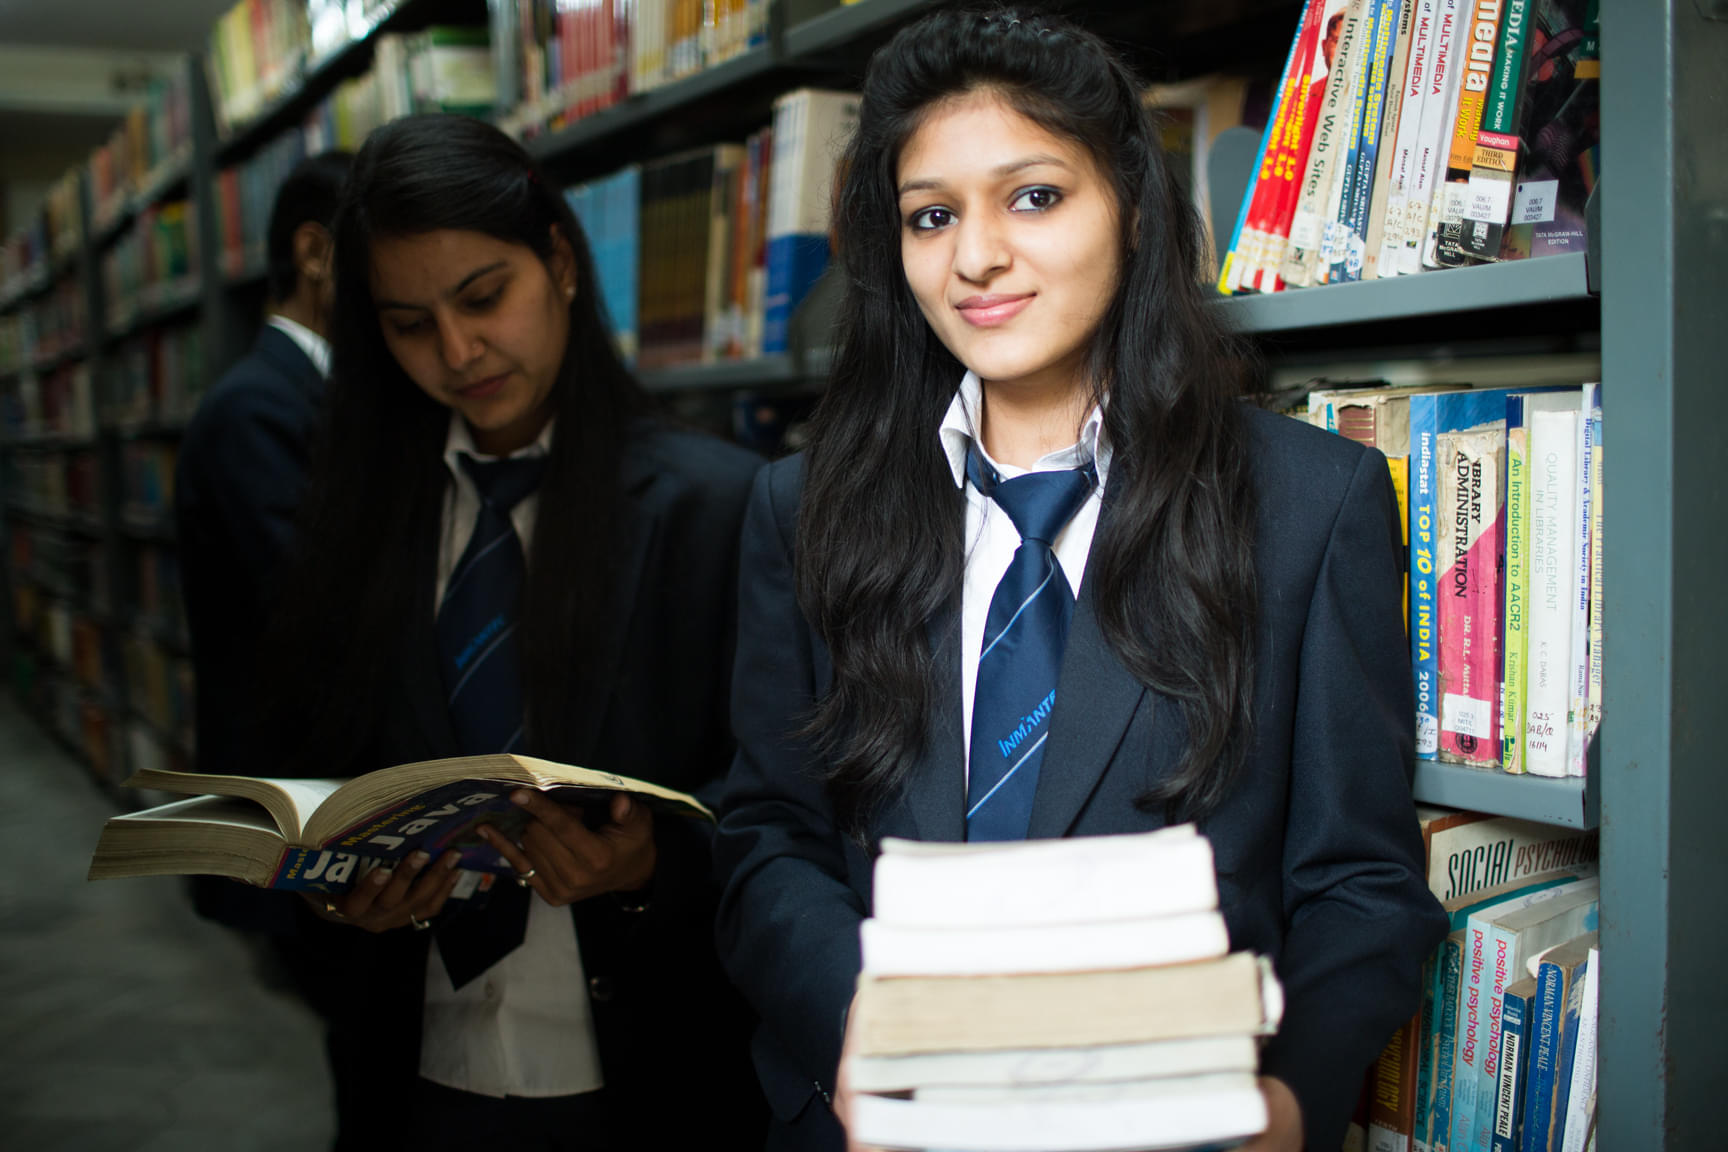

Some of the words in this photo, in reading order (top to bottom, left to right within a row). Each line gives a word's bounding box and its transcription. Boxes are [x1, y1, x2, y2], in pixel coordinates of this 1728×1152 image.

[1423, 2, 1432, 13] of
[1327, 18, 1358, 108] Interactive
[1357, 17, 1375, 98] Multimedia
[1375, 9, 1393, 91] Multimedia
[1409, 17, 1430, 97] MULTIMEDIA
[1431, 13, 1453, 96] MULTIMEDIA
[1268, 78, 1296, 150] Silverlight
[1290, 74, 1311, 150] Silverlight
[1499, 91, 1507, 100] IT
[1316, 114, 1336, 152] Web
[1349, 98, 1362, 150] System
[1367, 93, 1381, 145] System
[1455, 109, 1472, 138] Work
[1493, 101, 1505, 130] WORK
[1260, 157, 1274, 180] 1.0
[1284, 156, 1296, 181] 1.0
[1480, 149, 1503, 160] THIRD
[1307, 159, 1325, 197] Sites
[1547, 237, 1570, 246] EDITION
[1583, 418, 1593, 449] Digital
[1511, 459, 1523, 477] An
[1545, 452, 1558, 512] QUALITY
[1583, 451, 1592, 484] Library
[1535, 489, 1545, 502] IN
[1583, 487, 1590, 495] &
[1418, 504, 1430, 543] TOP
[1454, 450, 1470, 599] ADMINISTRATION
[1510, 481, 1523, 559] Introduction
[1581, 499, 1590, 540] Academic
[1534, 509, 1545, 574] LIBRARIES
[1579, 543, 1590, 572] Society
[1417, 548, 1432, 575] 10
[1510, 565, 1520, 577] to
[1545, 516, 1558, 611] MANAGEMENT
[1579, 575, 1588, 585] in
[1418, 580, 1431, 600] of
[1509, 583, 1521, 632] AACR2
[1579, 587, 1588, 610] India
[1418, 605, 1430, 662] INDIA
[1463, 615, 1472, 636] DR.
[1508, 651, 1520, 687] Krishan
[1418, 672, 1429, 713] 2006
[1506, 691, 1518, 723] Kumar
[367, 791, 501, 851] Java
[1445, 837, 1515, 901] SOCIAL
[1470, 928, 1485, 986] positive
[1493, 938, 1509, 996] positive
[1543, 967, 1558, 1007] NORMAN
[1461, 985, 1480, 1068] psychology
[1484, 995, 1504, 1080] psychology
[1540, 1006, 1554, 1042] VINCENT
[1505, 1032, 1516, 1075] NORMAN
[1536, 1042, 1550, 1072] PEALE
[1502, 1075, 1513, 1111] VINCENT
[1457, 1111, 1471, 1139] Alan
[1498, 1110, 1510, 1137] PEALE
